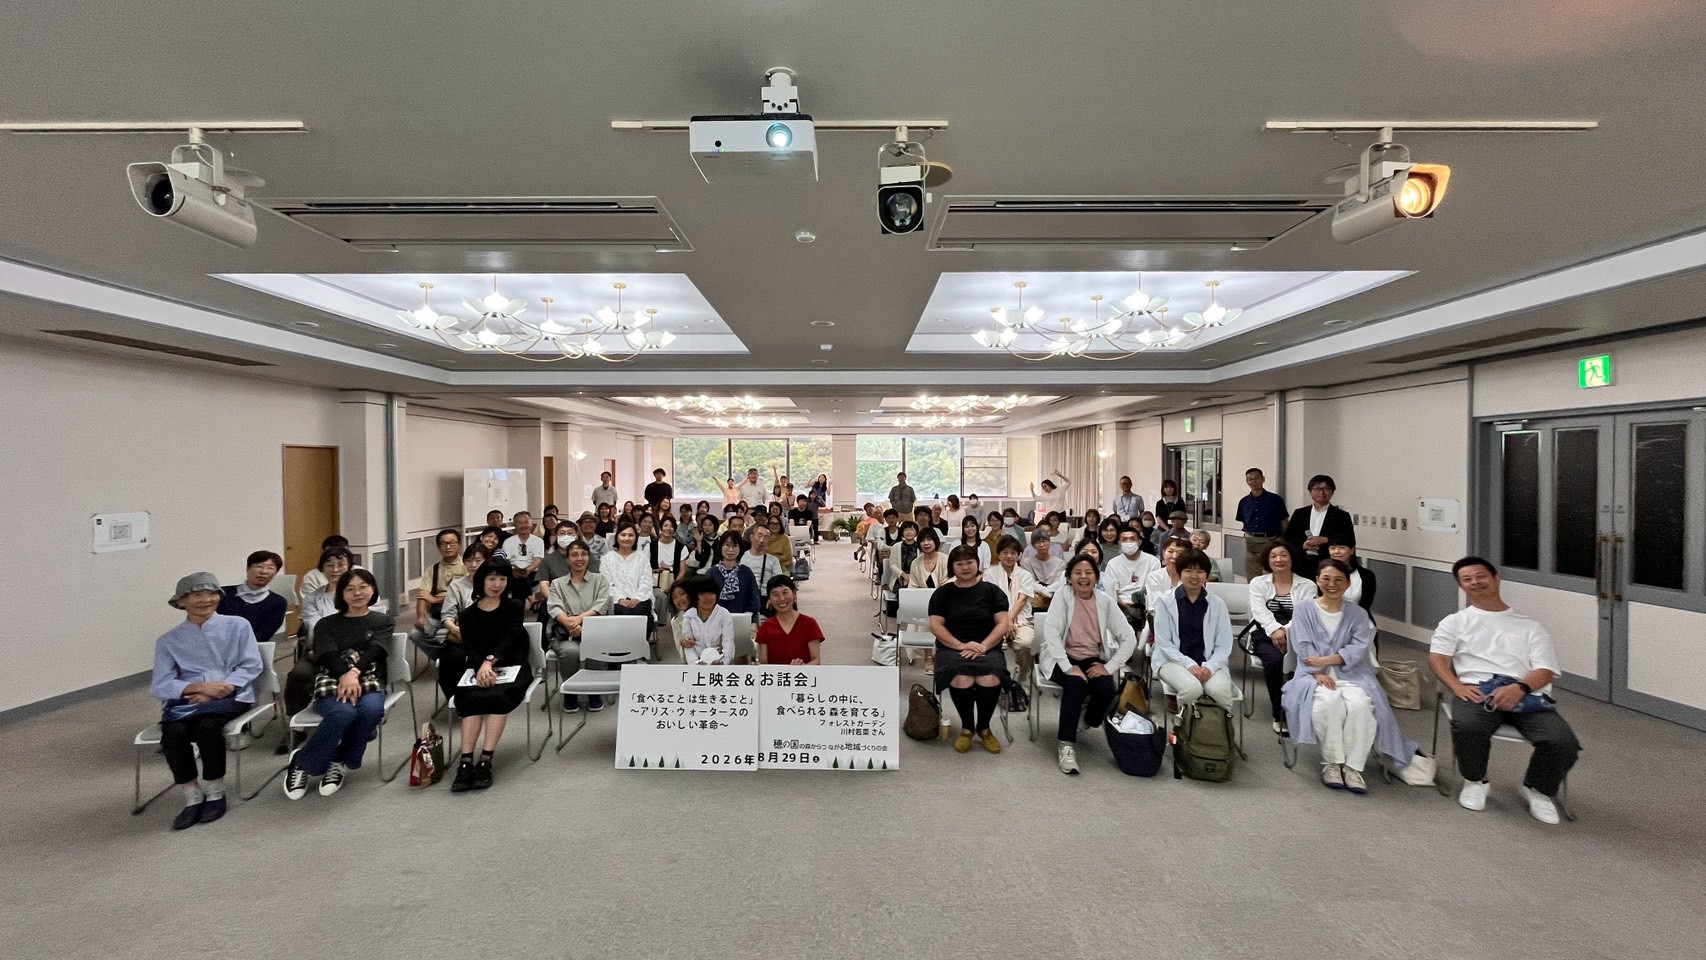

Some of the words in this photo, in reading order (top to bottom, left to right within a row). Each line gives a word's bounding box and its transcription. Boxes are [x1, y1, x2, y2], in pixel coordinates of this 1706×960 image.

[682, 671, 817, 688] 「上映会&お話会」
[631, 693, 753, 705] 「食べることは生きること」
[790, 693, 863, 705] 「暮らしの中に、
[776, 704, 886, 718] 食べられる森を育てる」
[819, 719, 886, 728] フォレストガーデン
